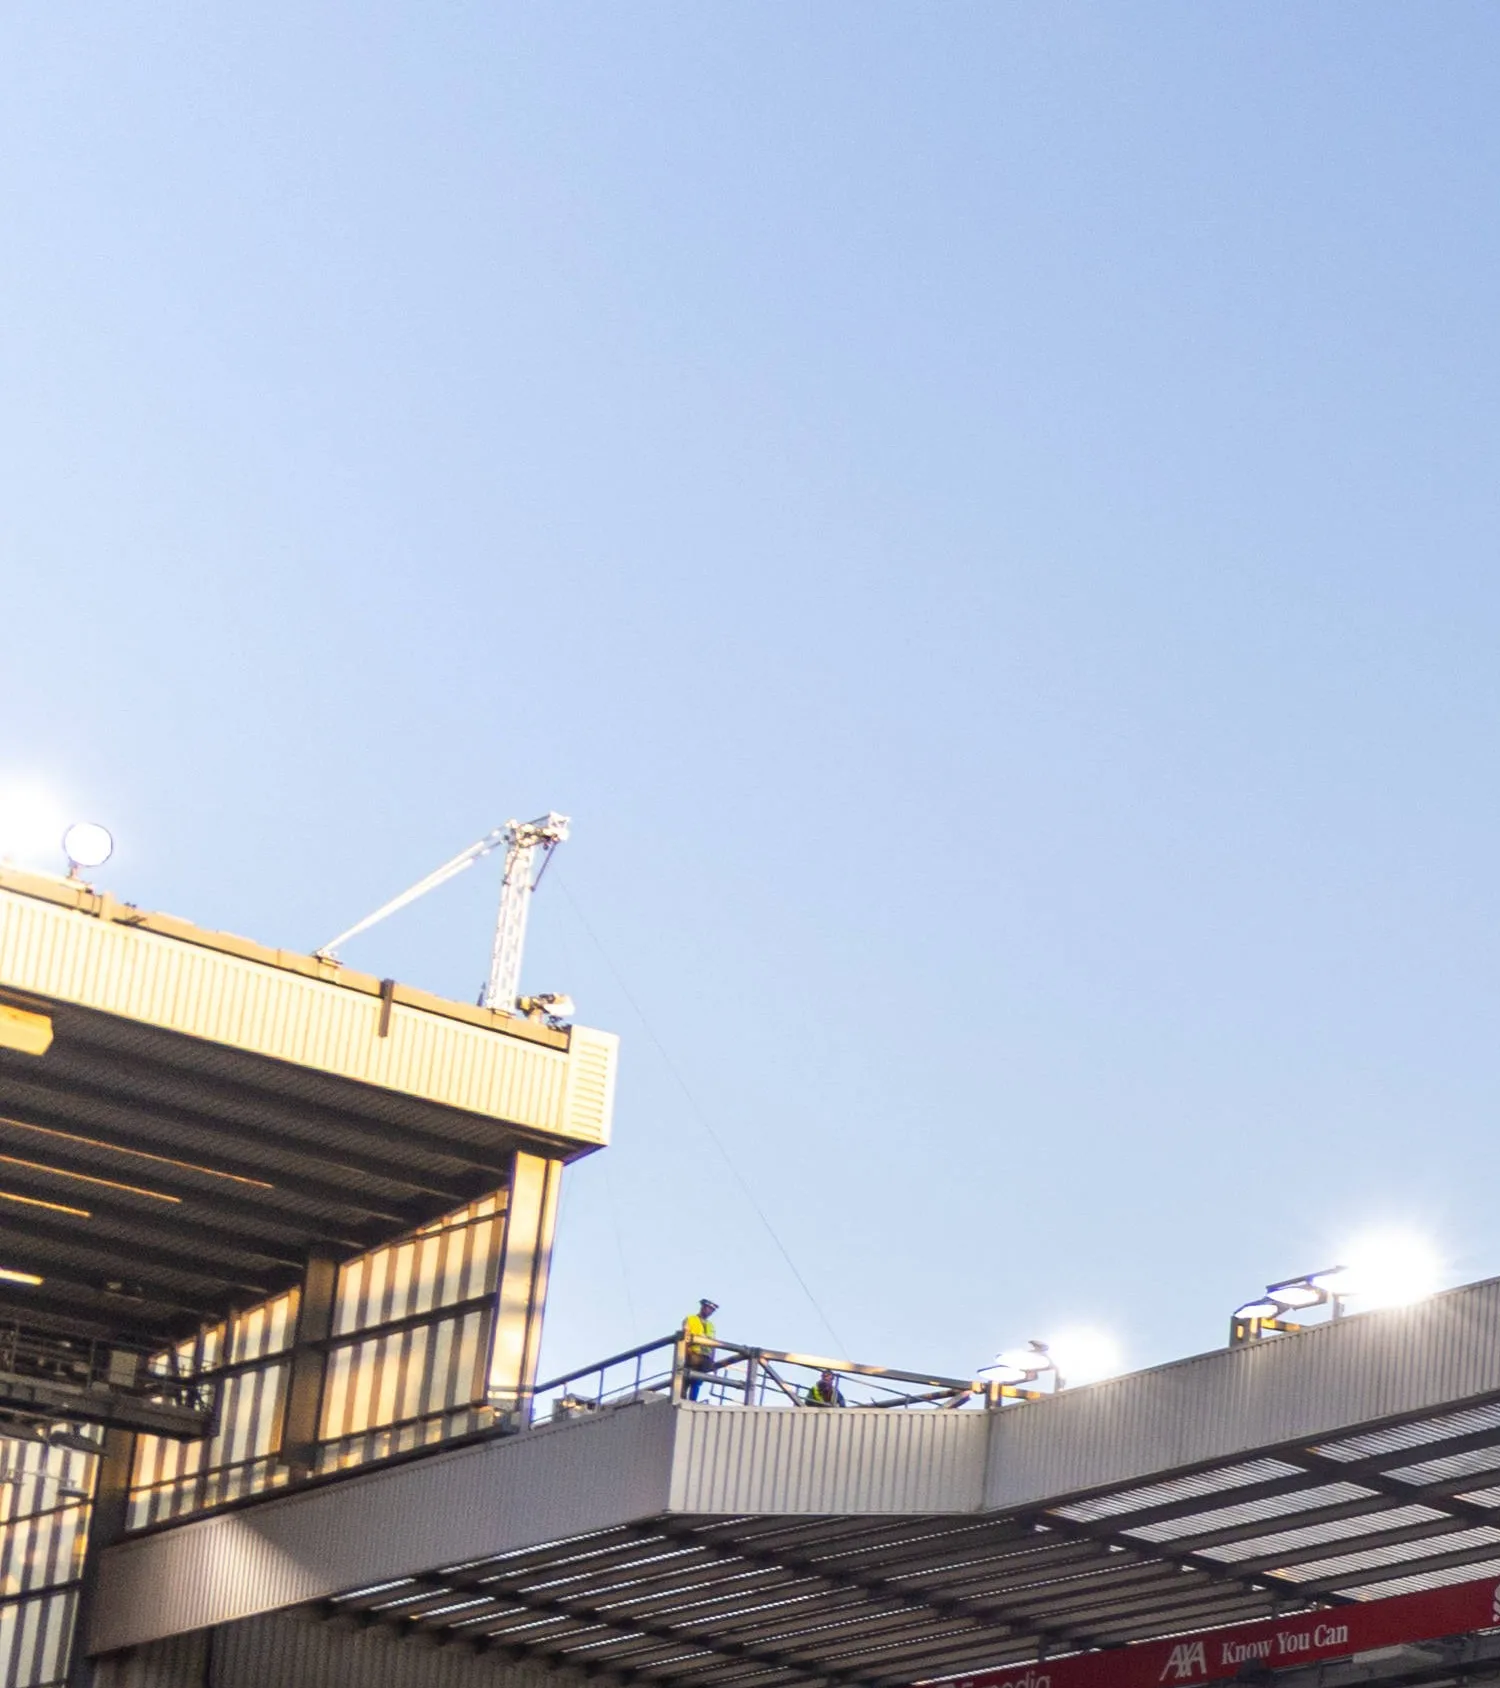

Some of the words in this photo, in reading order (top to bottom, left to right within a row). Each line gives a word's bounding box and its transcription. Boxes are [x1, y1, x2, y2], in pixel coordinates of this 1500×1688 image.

[1159, 1641, 1207, 1682] AXA
[1221, 1640, 1273, 1666] Know
[1275, 1630, 1310, 1655] You
[1314, 1623, 1349, 1648] Can
